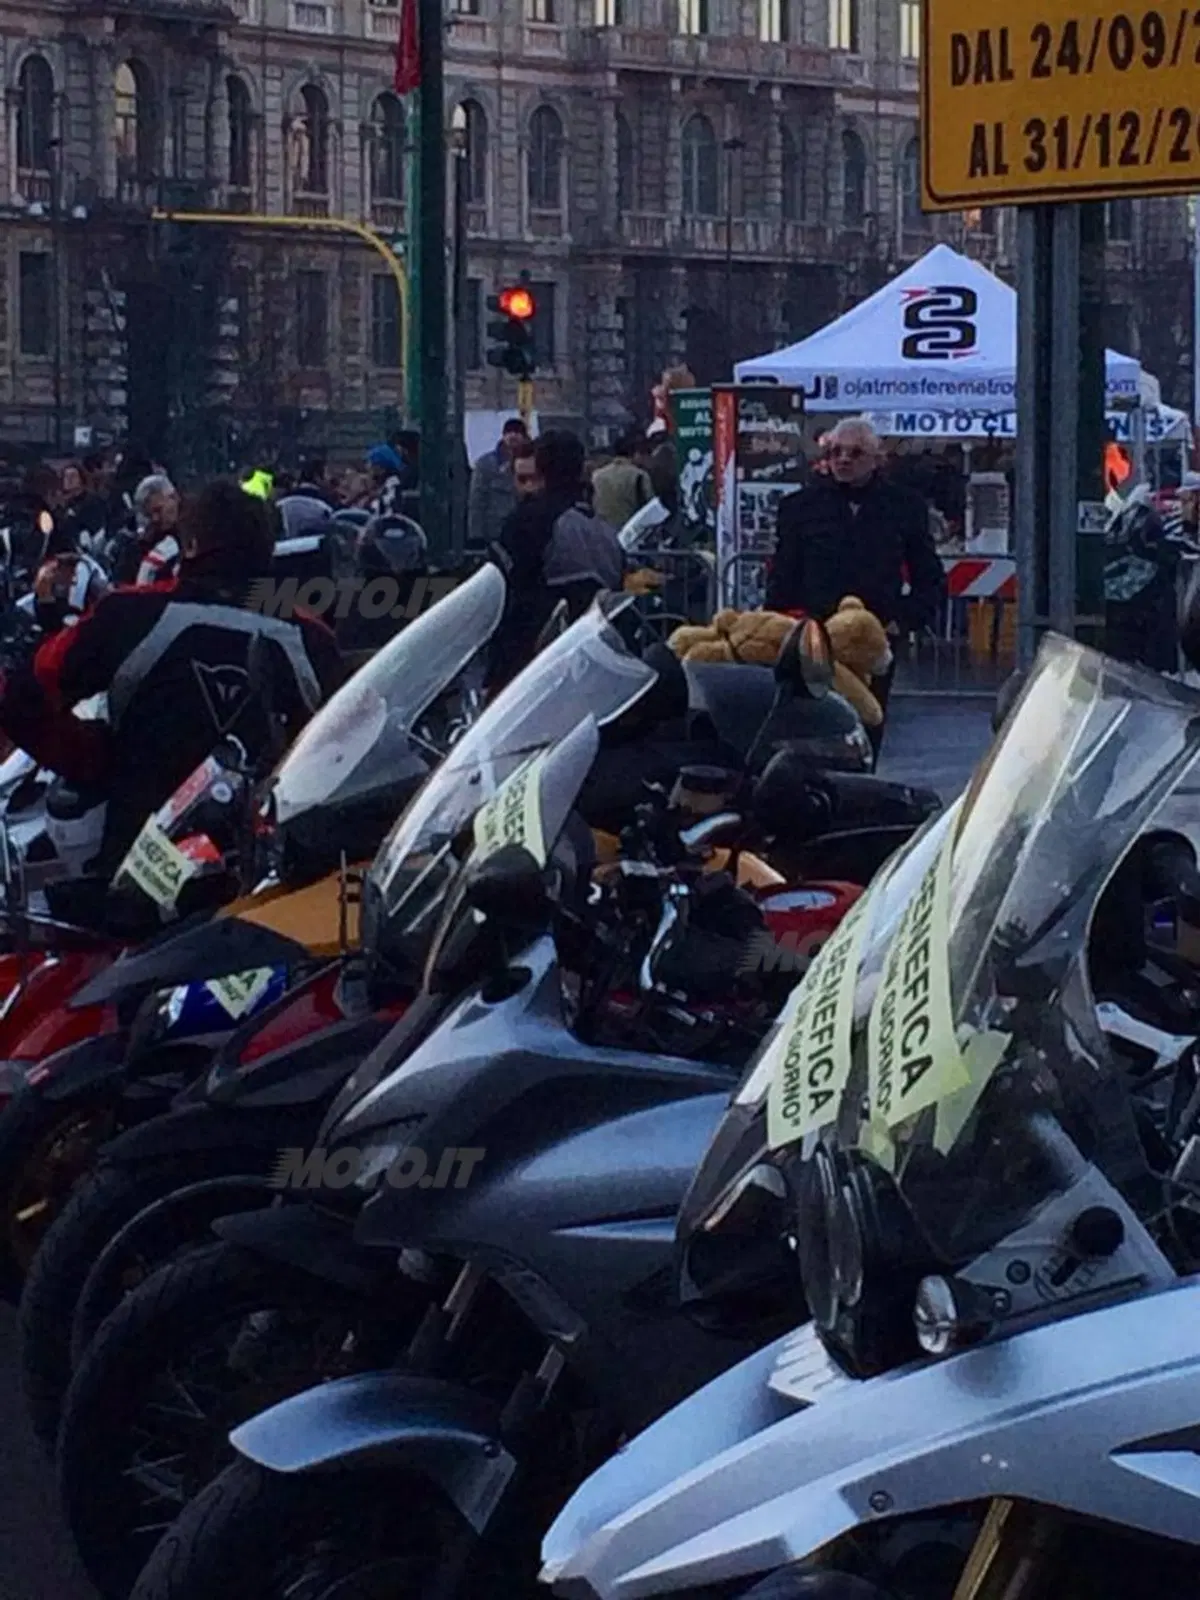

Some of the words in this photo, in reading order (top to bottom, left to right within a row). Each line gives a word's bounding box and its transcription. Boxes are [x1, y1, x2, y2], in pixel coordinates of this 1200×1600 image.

[951, 27, 1014, 87] DAL
[969, 121, 1009, 178] AL
[1023, 107, 1200, 173] 31/12/2
[844, 376, 1017, 399] ojatmosferemetro
[1105, 379, 1137, 394] om
[895, 411, 972, 432] MOTO
[982, 411, 1016, 433] CL
